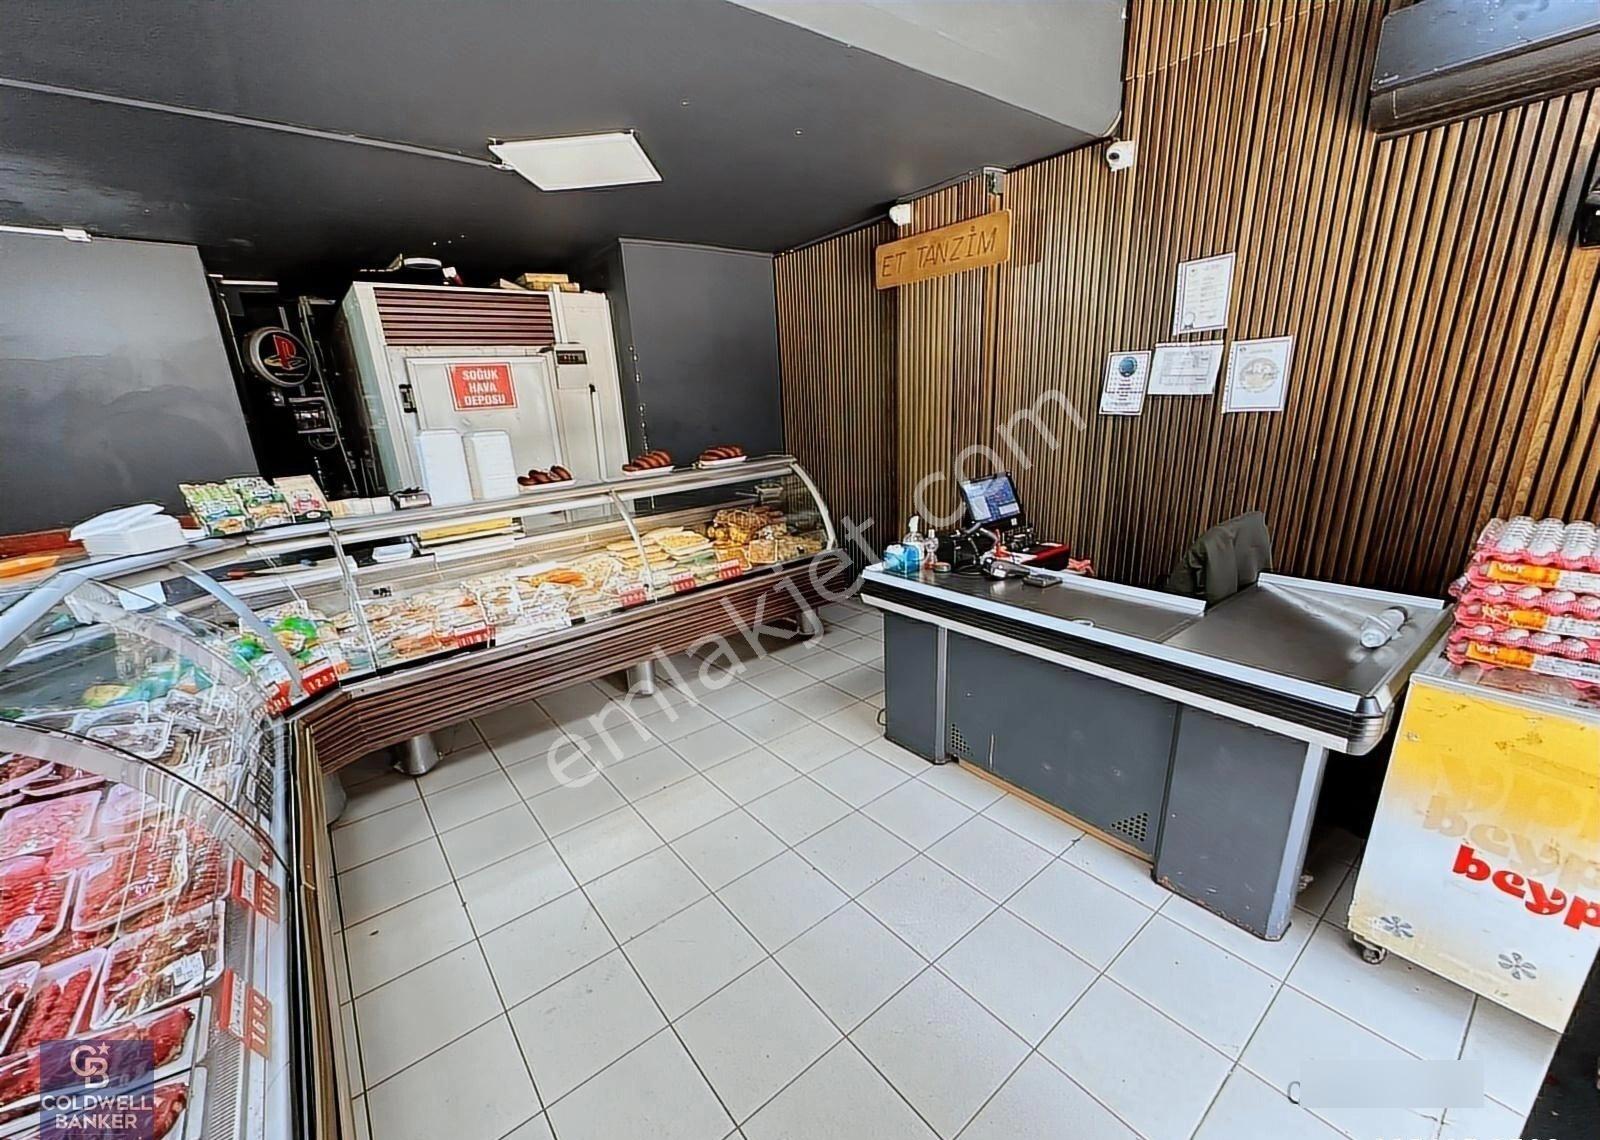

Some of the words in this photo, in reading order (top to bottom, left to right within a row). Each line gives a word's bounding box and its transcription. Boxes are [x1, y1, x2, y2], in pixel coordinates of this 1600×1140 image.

[881, 251, 907, 278] ET
[916, 225, 998, 269] TANZİM
[462, 367, 500, 381] SOĞUK
[468, 381, 498, 394] HAVA
[463, 394, 506, 406] DEPOSU
